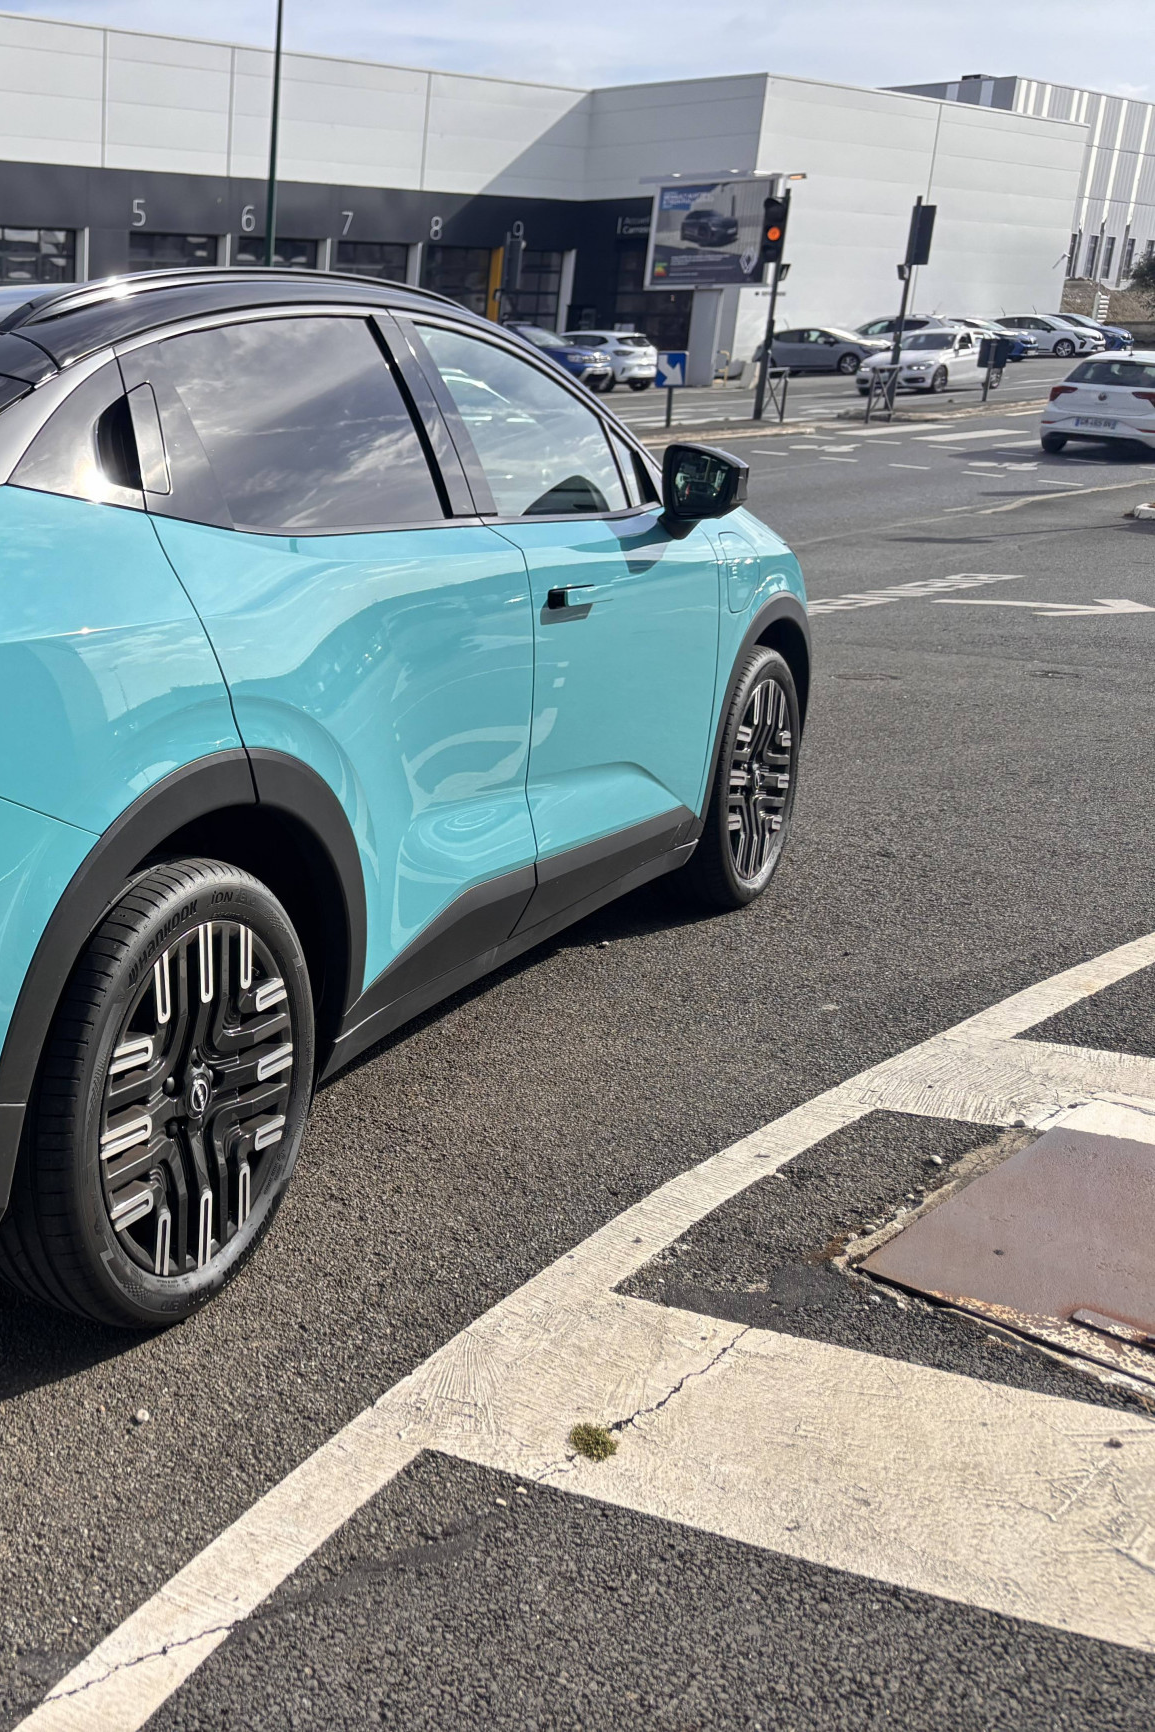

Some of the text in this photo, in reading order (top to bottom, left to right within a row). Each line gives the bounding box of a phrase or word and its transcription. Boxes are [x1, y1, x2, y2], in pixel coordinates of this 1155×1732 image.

[132, 199, 146, 227] 5
[241, 205, 256, 232] 6
[341, 211, 354, 236] 7
[429, 216, 443, 241] 8
[806, 573, 1027, 616] BIENVEN
